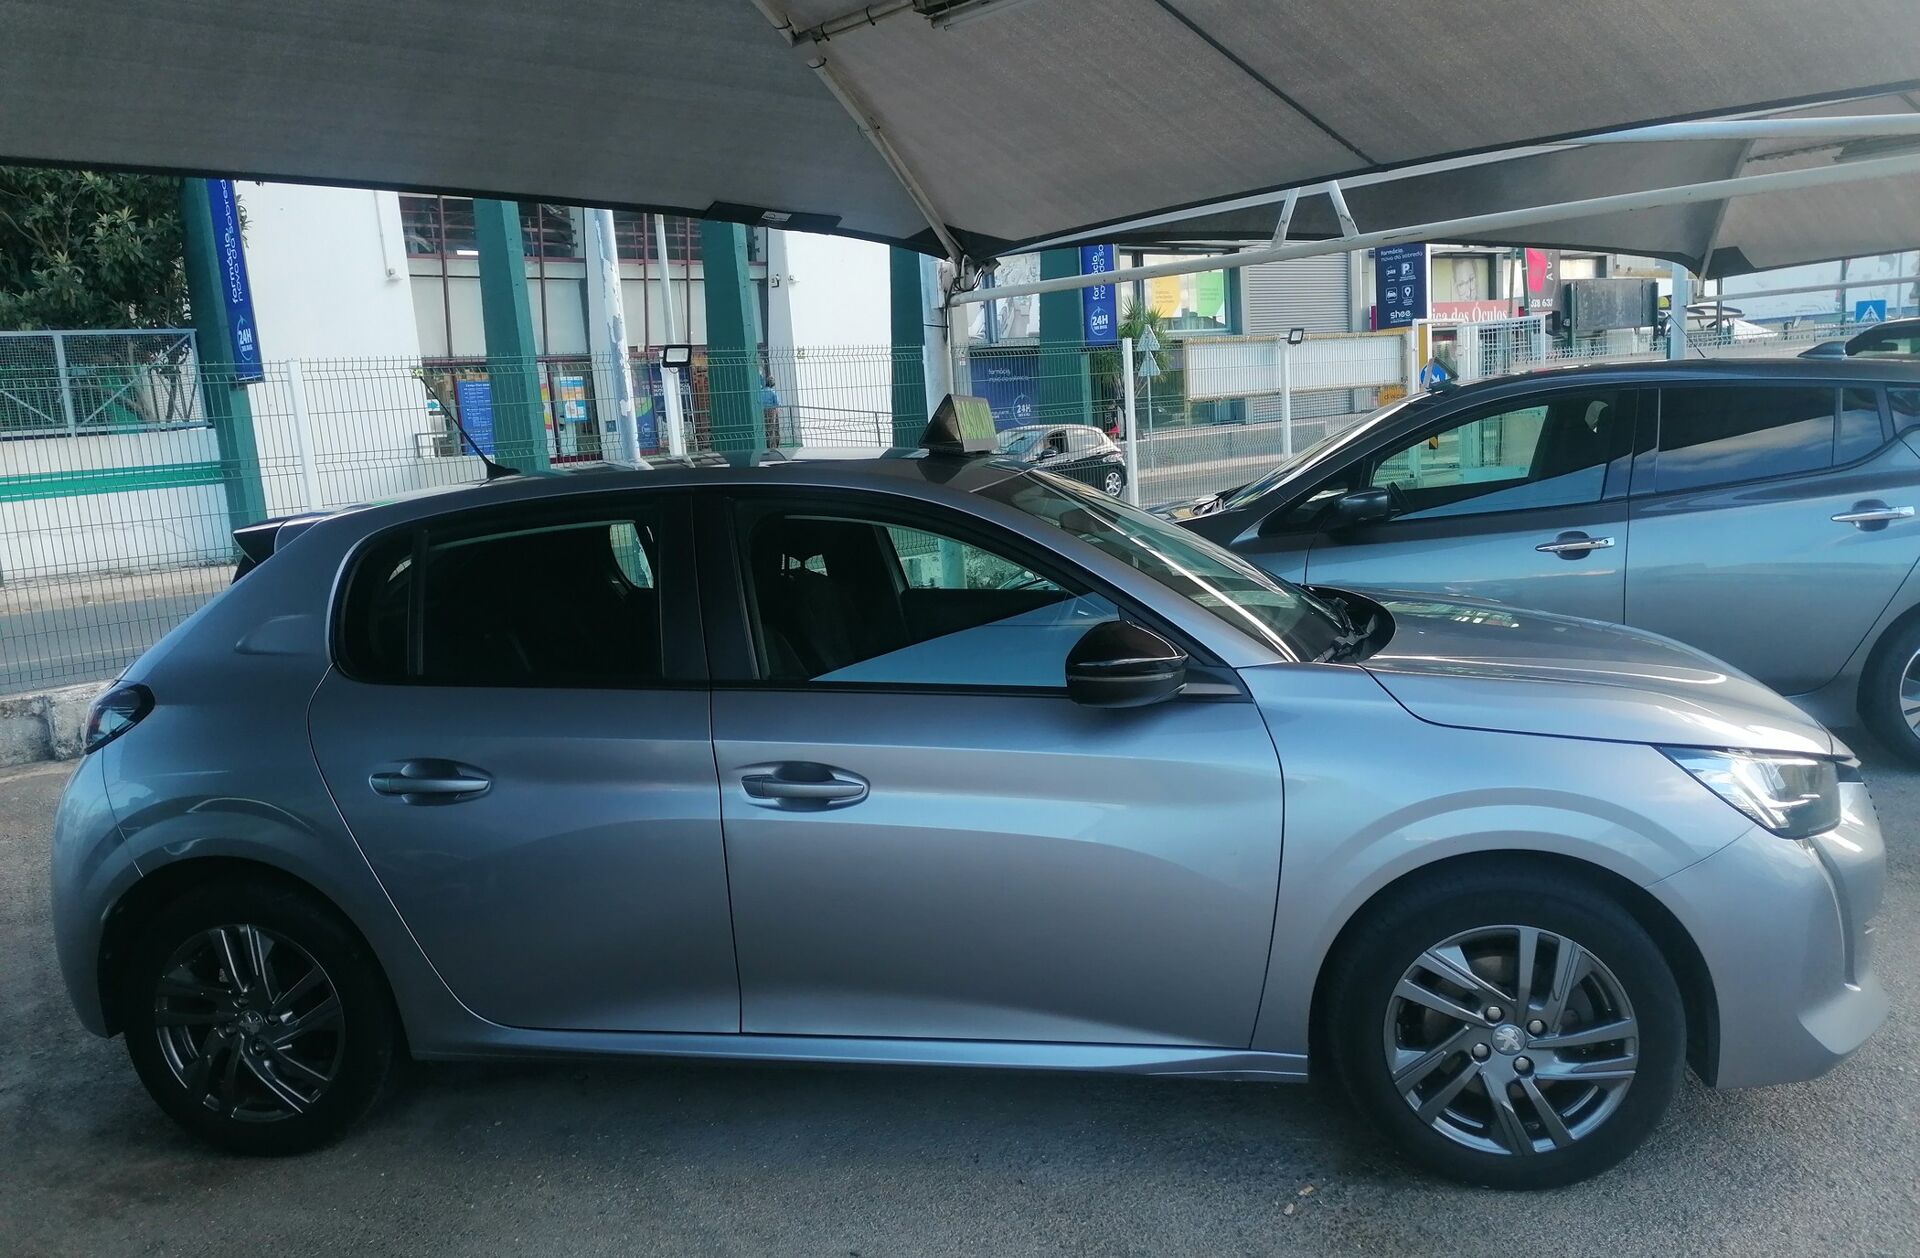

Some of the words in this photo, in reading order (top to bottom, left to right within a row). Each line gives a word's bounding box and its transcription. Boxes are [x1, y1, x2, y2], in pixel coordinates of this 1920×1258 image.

[230, 238, 238, 259] da
[234, 263, 243, 302] nova
[1092, 314, 1108, 326] 24H
[1471, 302, 1508, 323] Óculos
[237, 328, 252, 345] 24H
[1016, 404, 1031, 413] 24H
